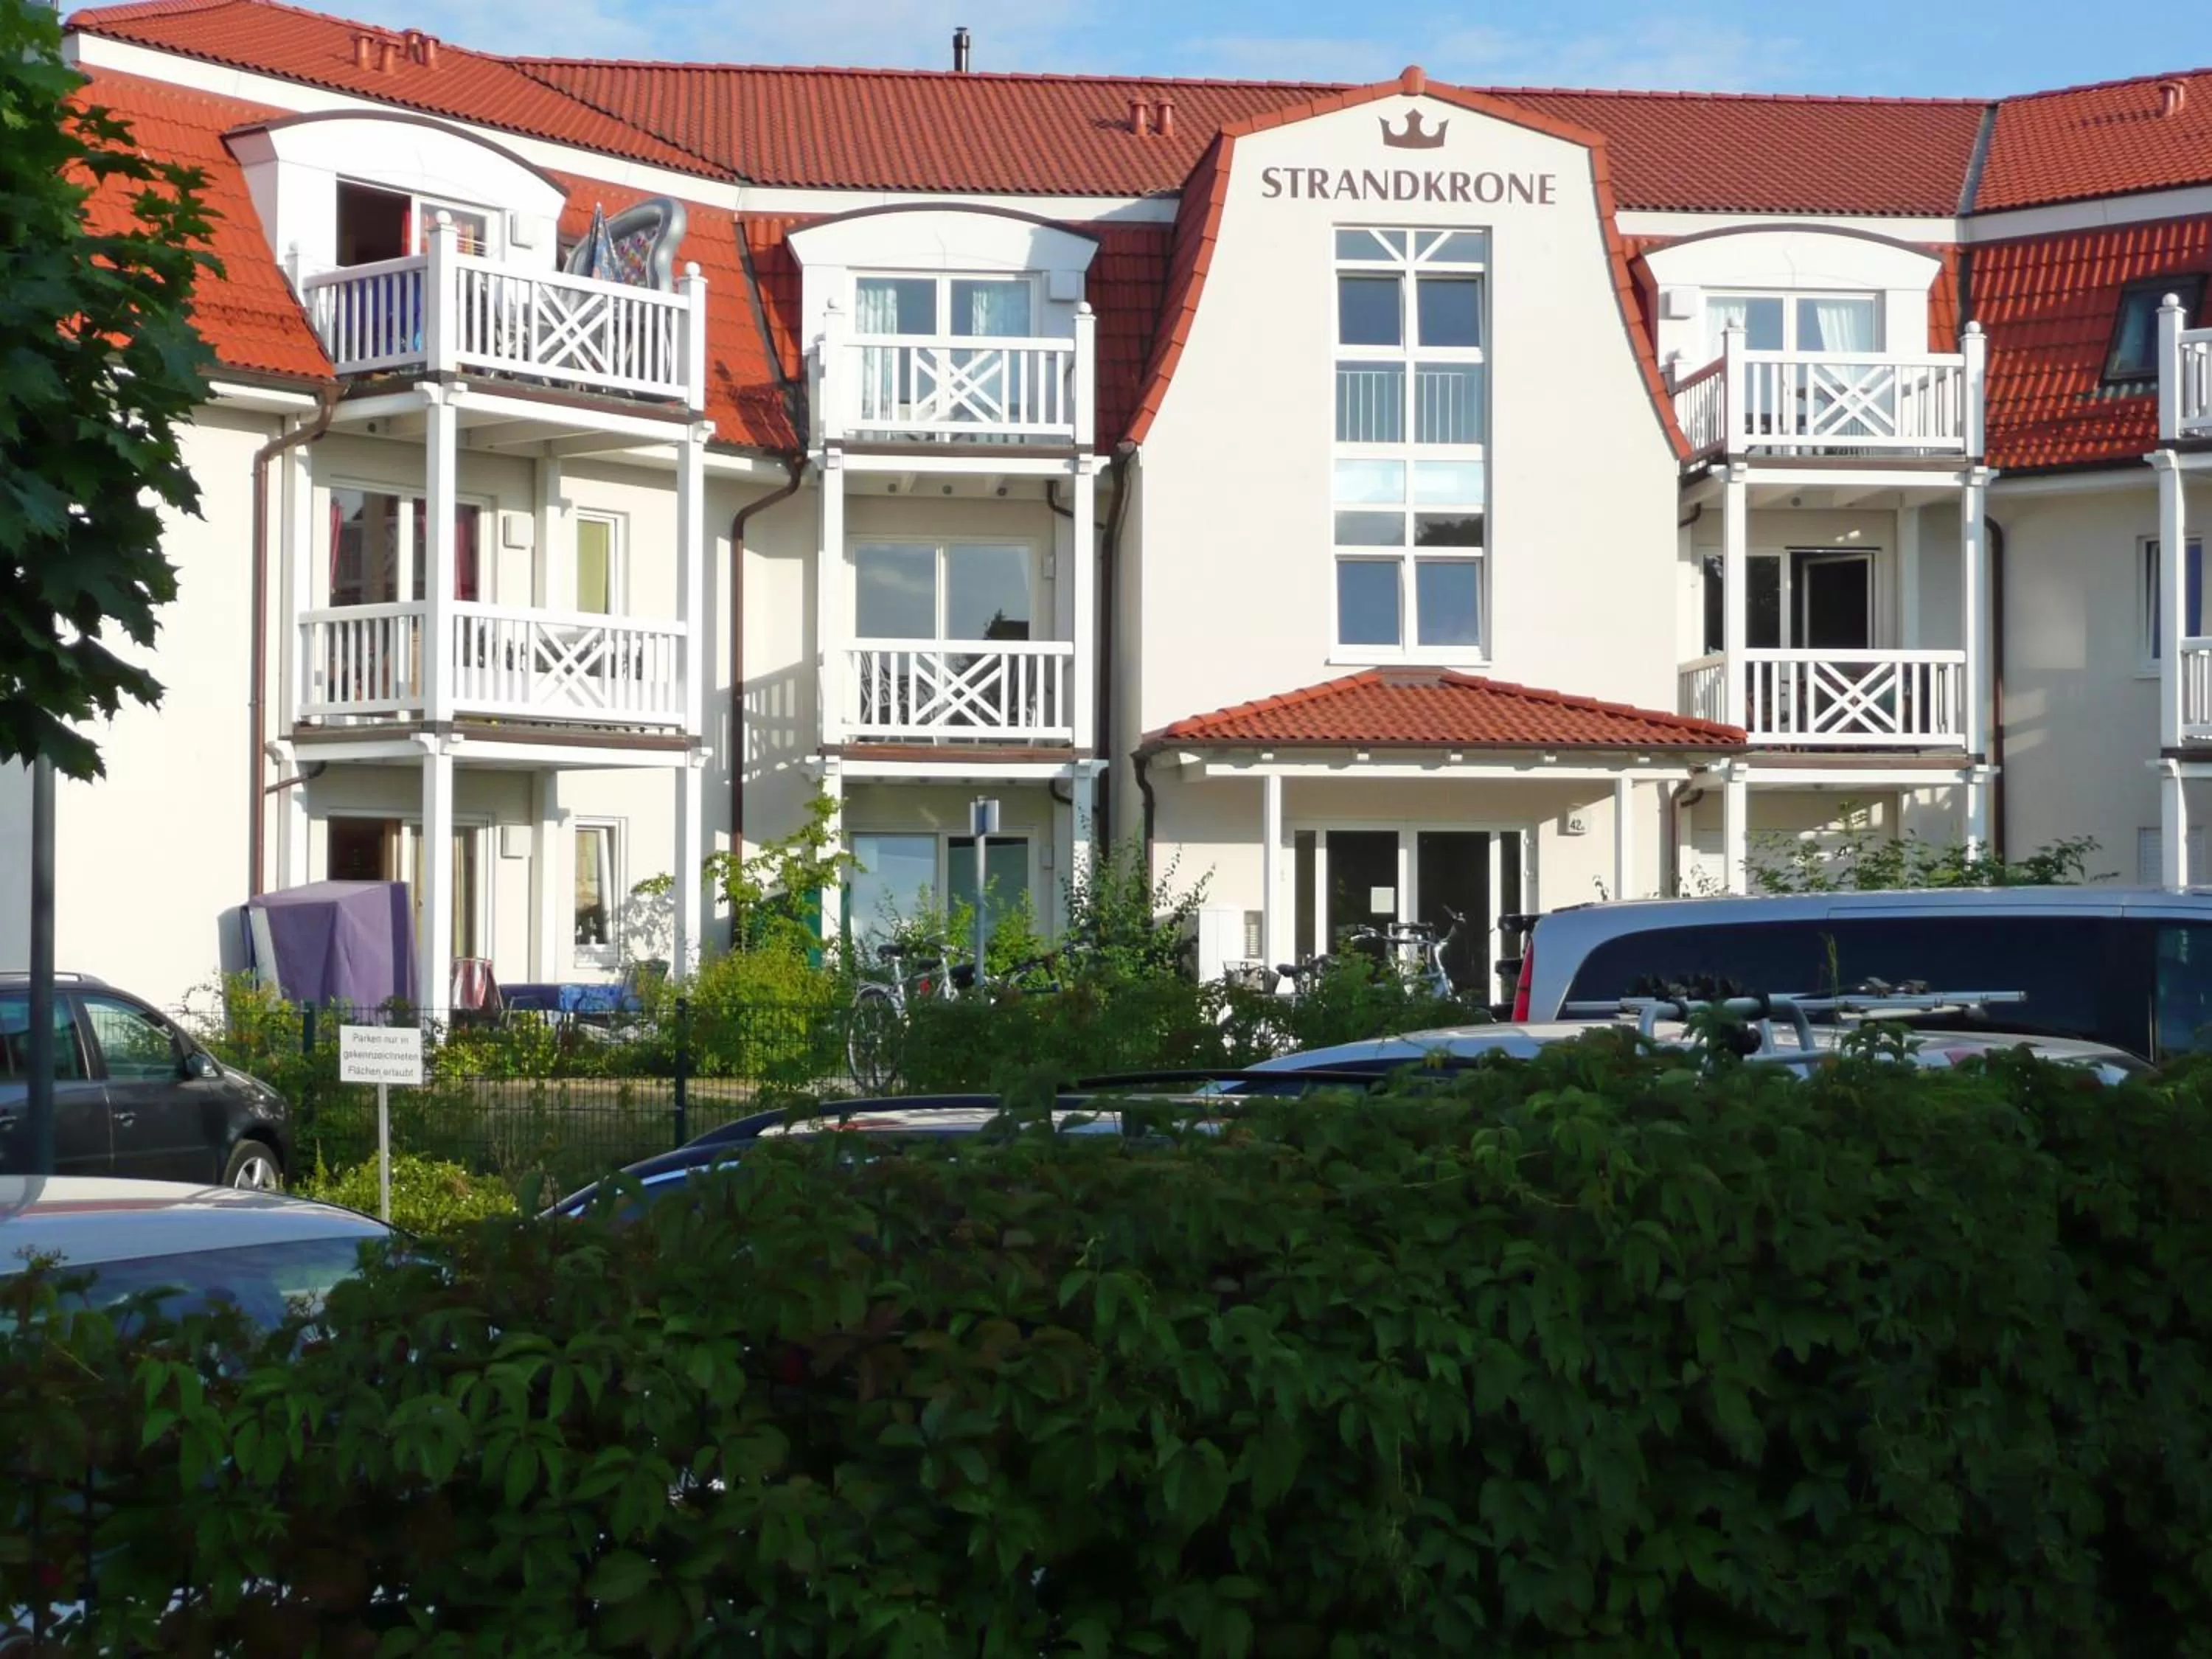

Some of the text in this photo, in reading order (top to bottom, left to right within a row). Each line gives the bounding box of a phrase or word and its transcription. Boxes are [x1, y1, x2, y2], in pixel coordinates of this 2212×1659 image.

[1262, 167, 1556, 204] STRANDKRONE
[352, 1032, 381, 1043] Parken
[383, 1035, 398, 1044] nur
[347, 1065, 414, 1077] Flächen erlaubt
